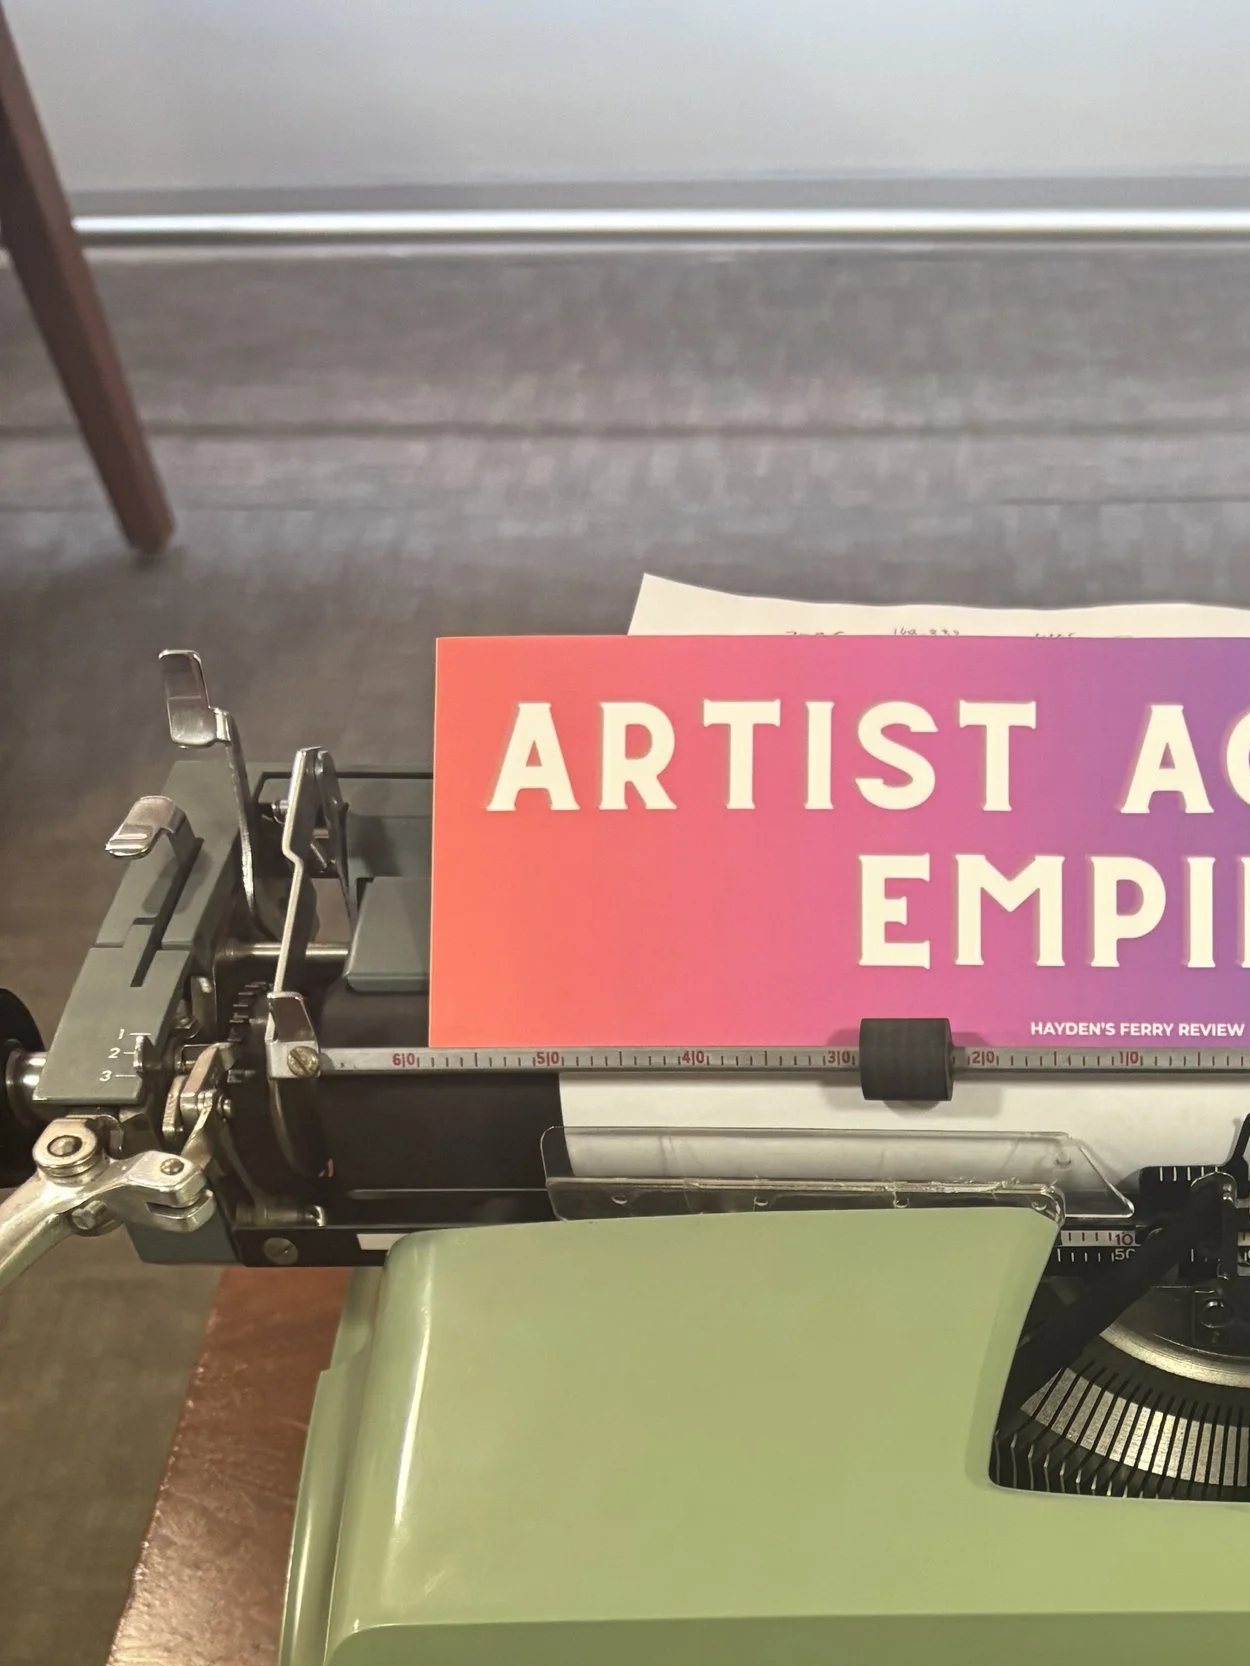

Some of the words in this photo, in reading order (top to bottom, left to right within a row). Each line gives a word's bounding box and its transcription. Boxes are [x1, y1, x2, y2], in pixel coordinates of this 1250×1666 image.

[485, 698, 1037, 812] ARTIST
[117, 1028, 125, 1040] 1
[1030, 1021, 1116, 1036] HAYDEN'S
[1120, 1022, 1174, 1037] FERRY
[1178, 1023, 1245, 1037] REVIEW
[107, 1047, 121, 1059] 2
[536, 1051, 561, 1066] 50
[681, 1050, 705, 1066] 40
[827, 1050, 851, 1065] 30
[971, 1050, 996, 1065] 20
[99, 1069, 113, 1082] 3
[1114, 1233, 1134, 1246] 10
